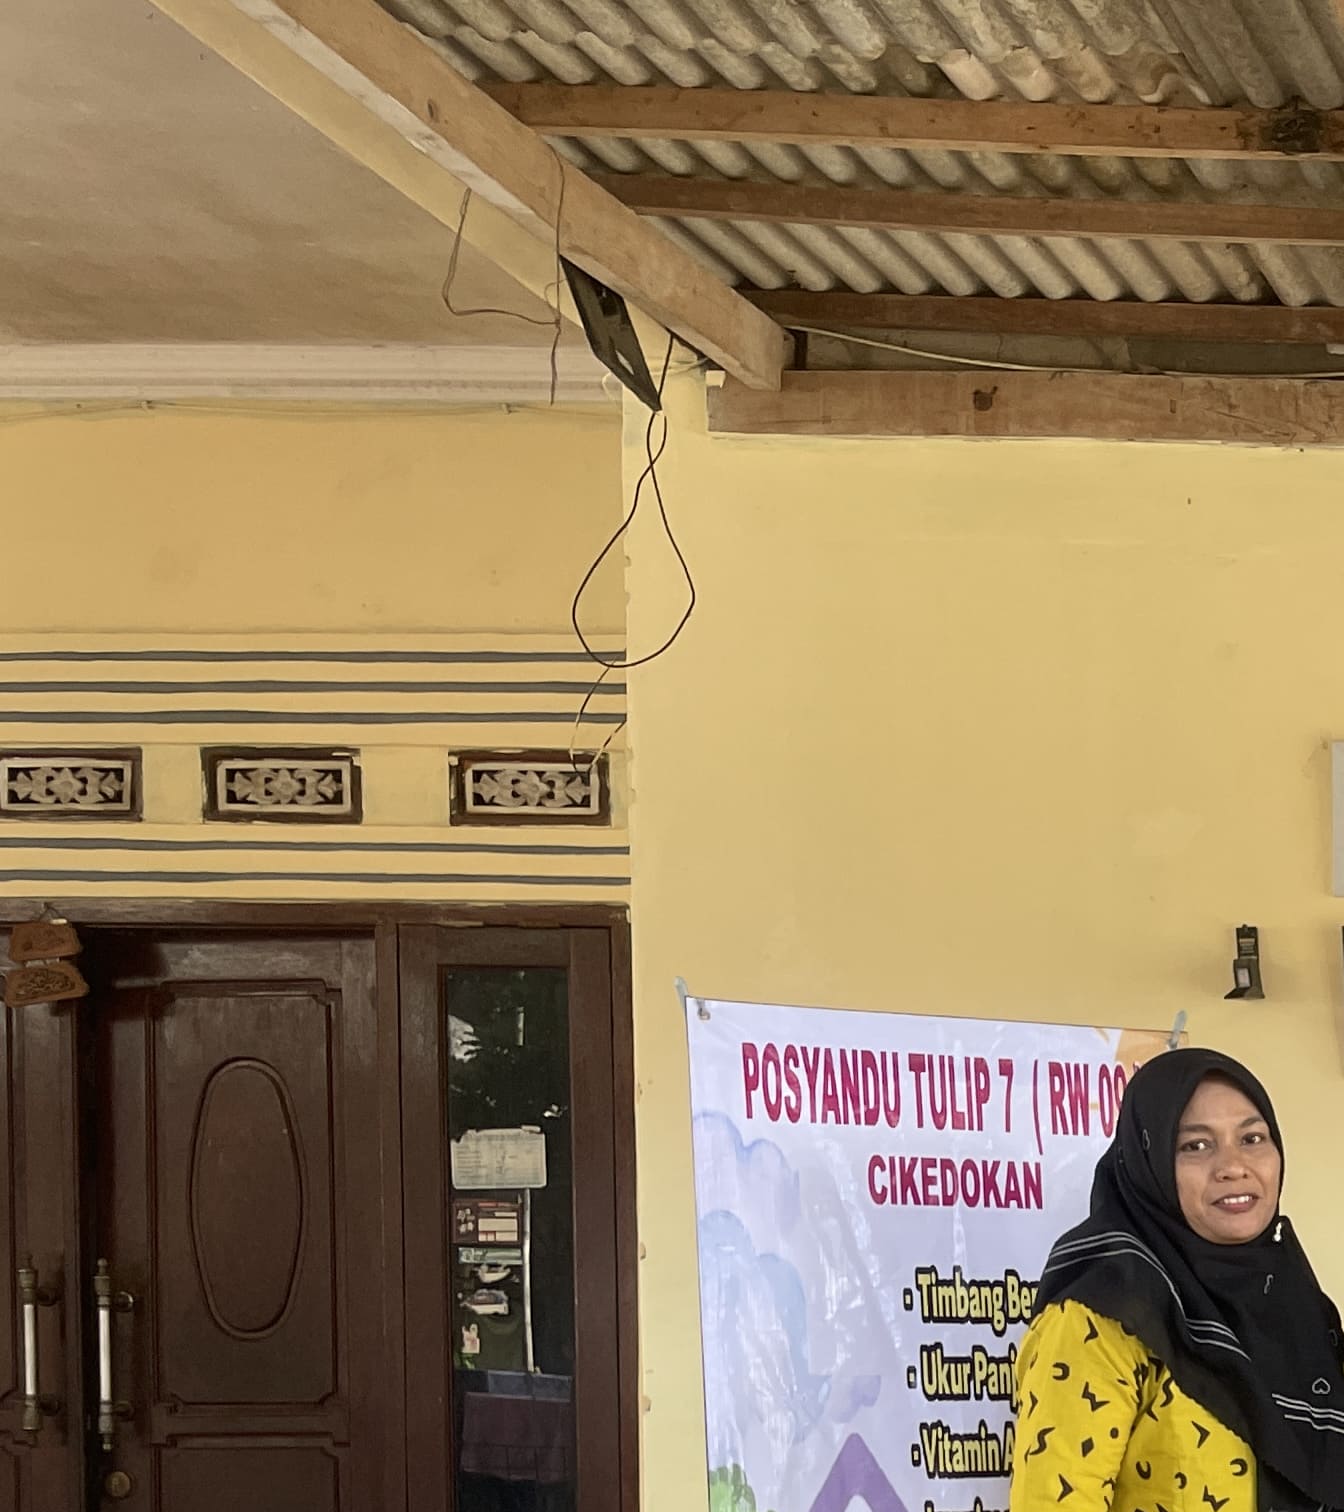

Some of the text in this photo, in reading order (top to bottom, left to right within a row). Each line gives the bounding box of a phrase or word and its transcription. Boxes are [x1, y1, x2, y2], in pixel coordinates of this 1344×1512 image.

[742, 1042, 900, 1129] POSYANDU
[908, 1053, 990, 1132] TULIP
[999, 1058, 1013, 1133] 7
[868, 1154, 1043, 1210] CIKEDOKAN
[915, 1265, 1006, 1337] Timbang
[920, 1342, 971, 1401] Ukur
[919, 1419, 1003, 1479] Vitamin
